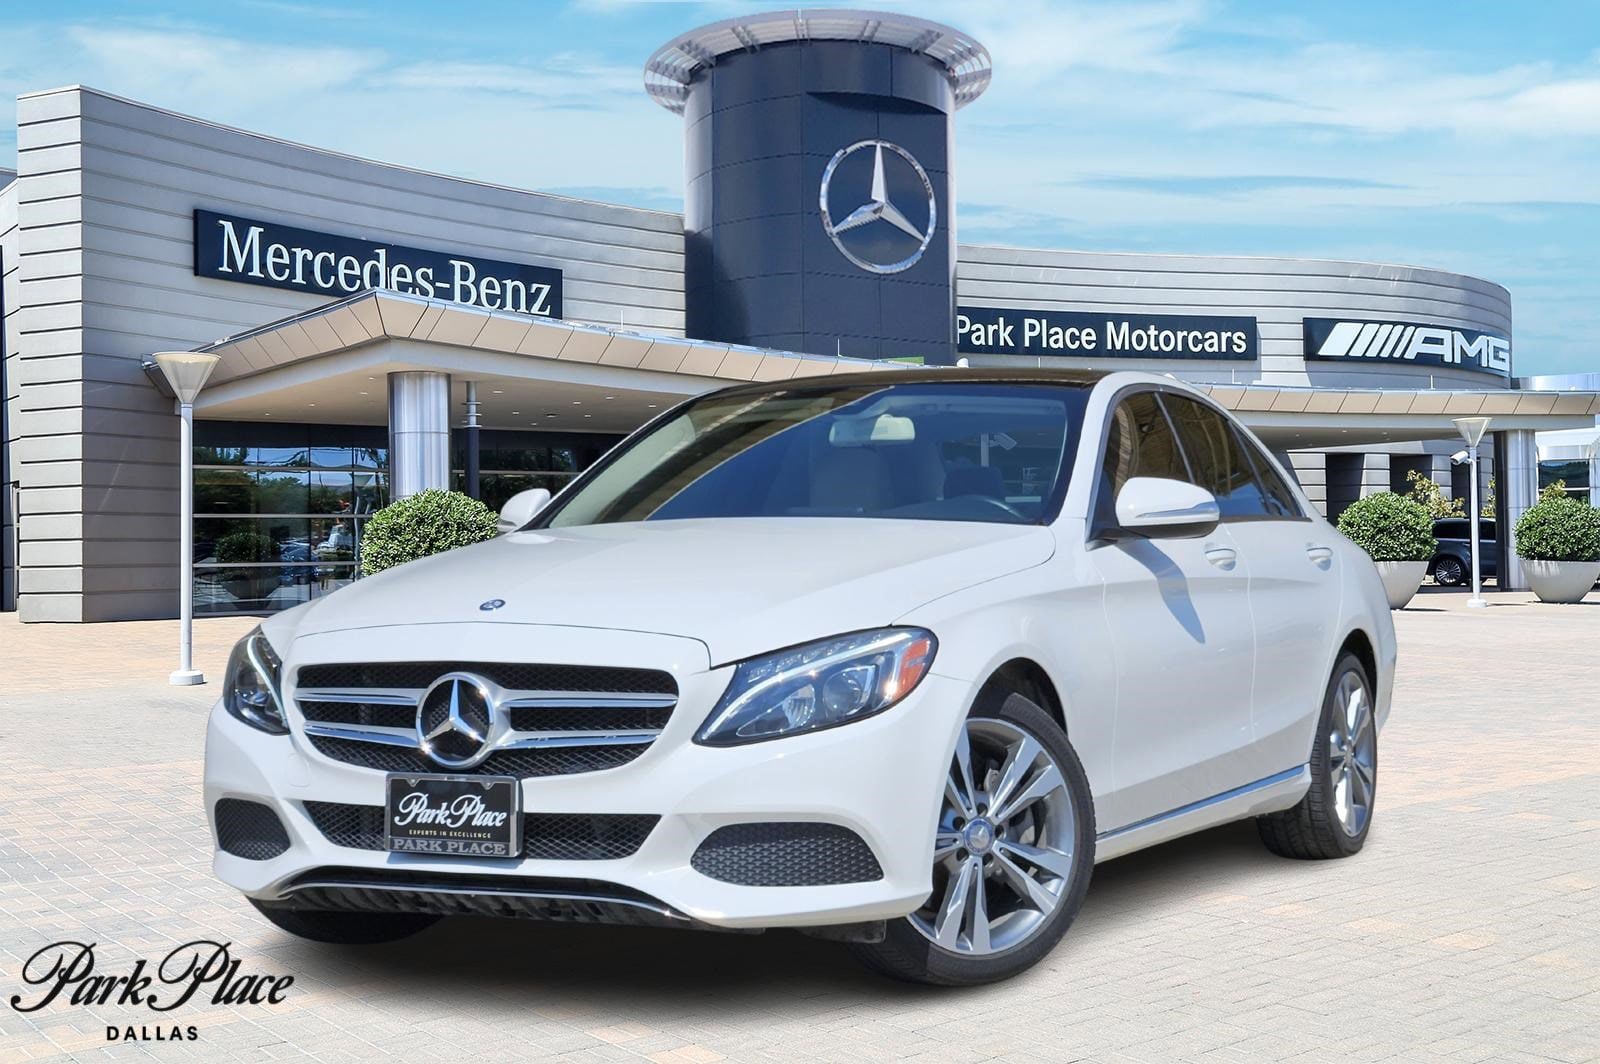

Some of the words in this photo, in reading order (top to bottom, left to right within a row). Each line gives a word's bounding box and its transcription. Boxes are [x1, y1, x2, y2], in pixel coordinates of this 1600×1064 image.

[218, 220, 552, 316] Mercedes-Benz
[957, 315, 1015, 347] Park
[1024, 318, 1097, 350] Place
[1106, 321, 1248, 353] Motorcars
[1404, 327, 1510, 372] AMG
[394, 792, 450, 826] Park
[446, 794, 508, 828] Place
[394, 839, 442, 852] PARK
[447, 841, 506, 855] PLACE
[449, 831, 491, 839] EXCELLENCE
